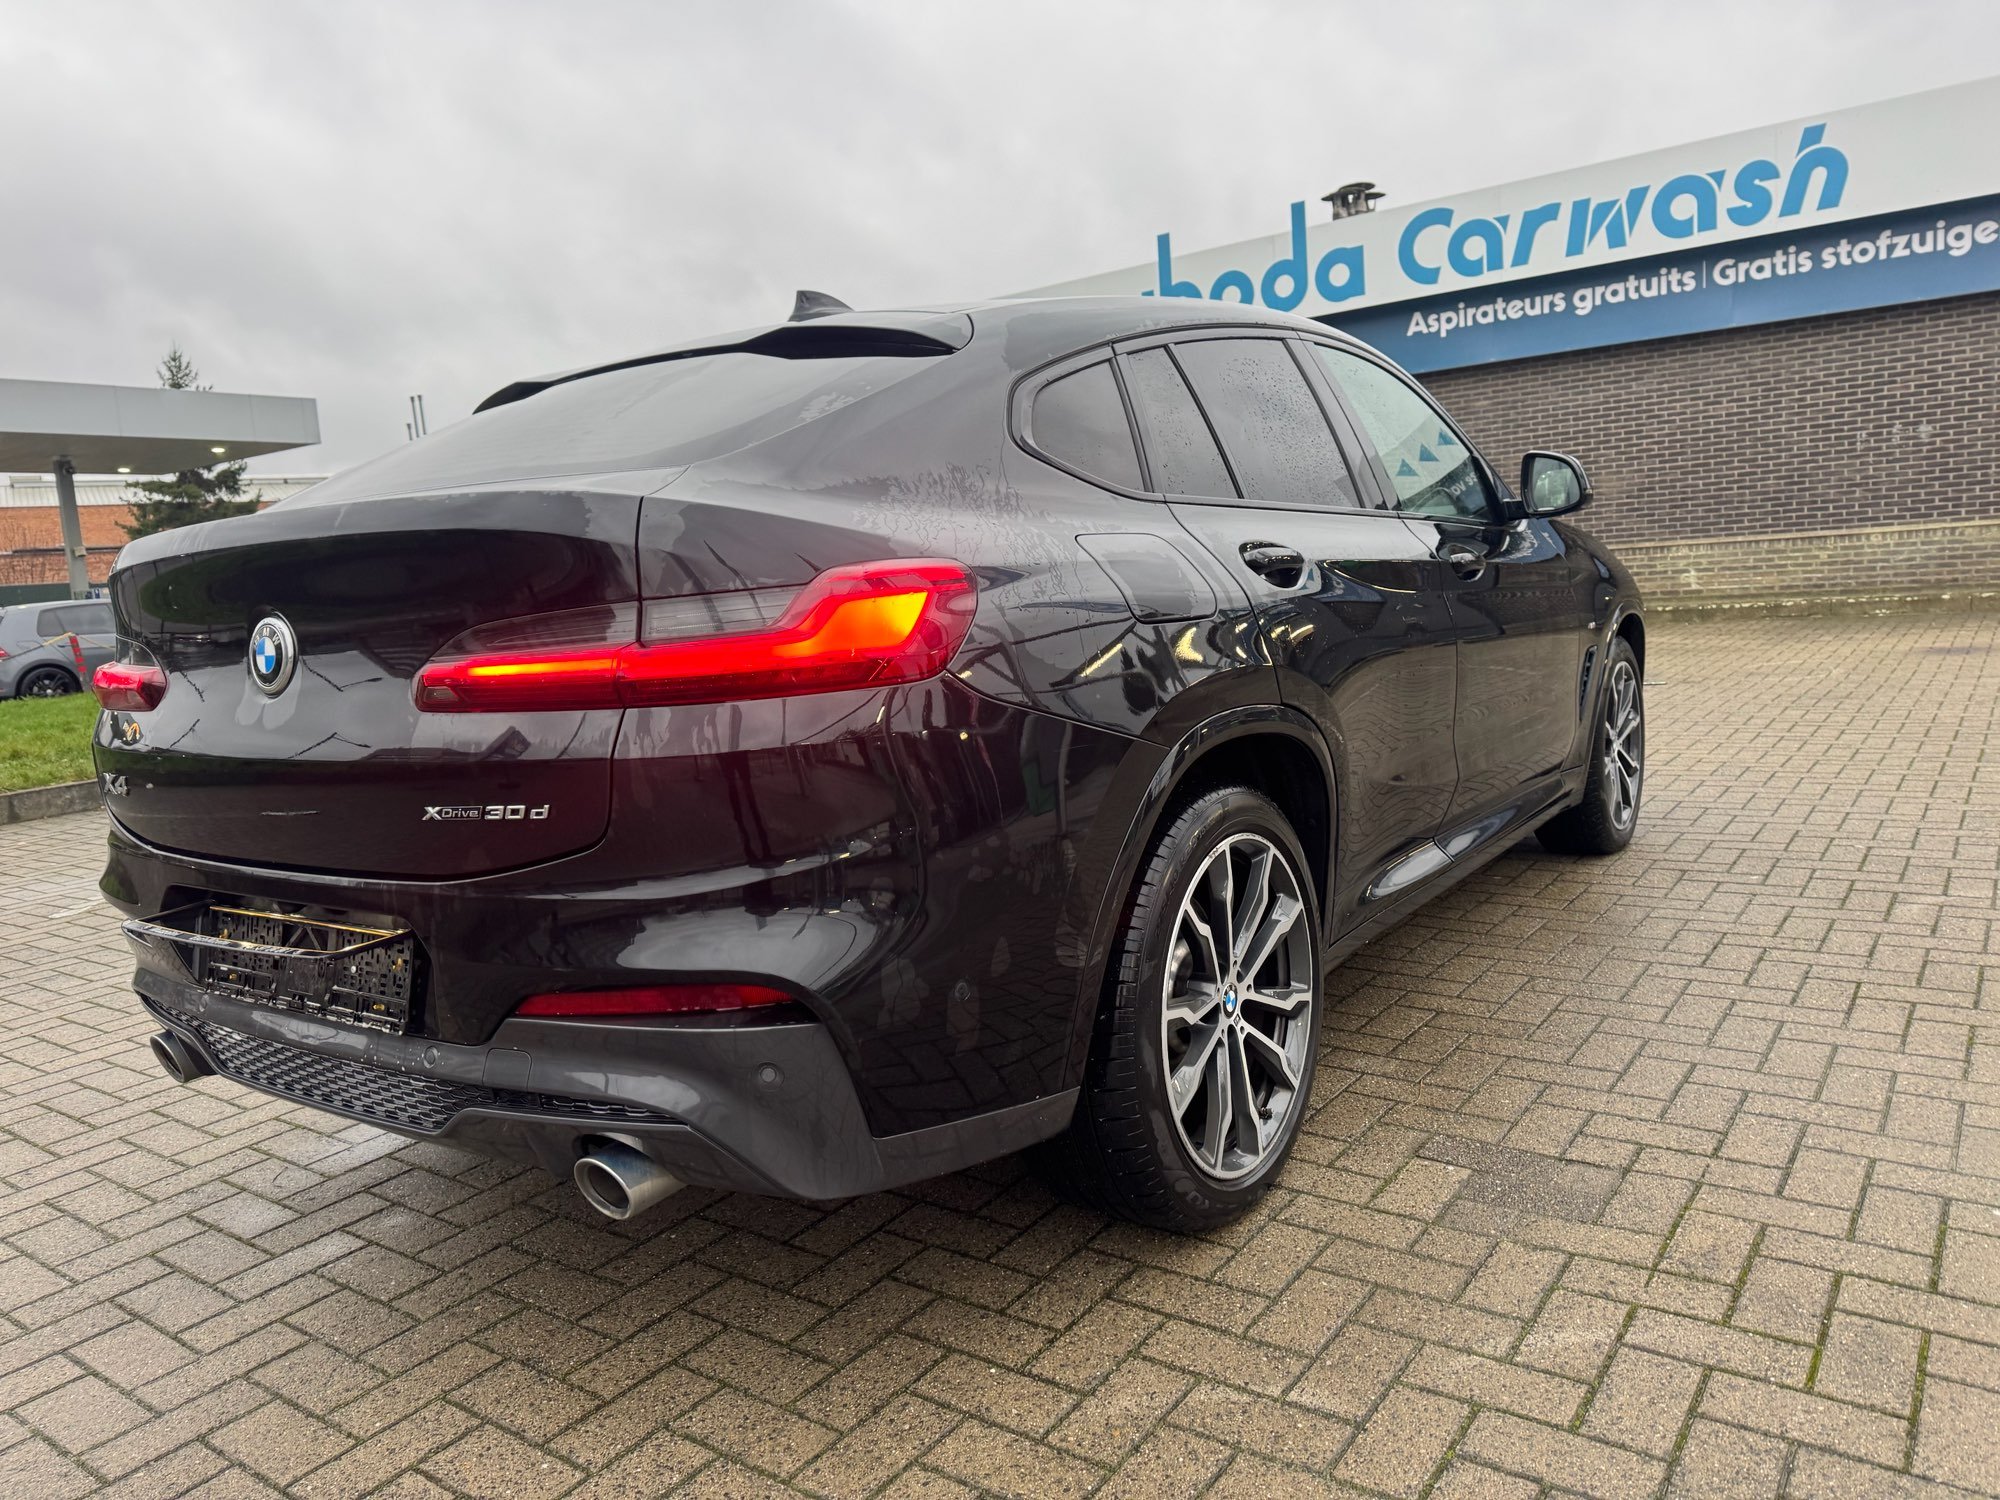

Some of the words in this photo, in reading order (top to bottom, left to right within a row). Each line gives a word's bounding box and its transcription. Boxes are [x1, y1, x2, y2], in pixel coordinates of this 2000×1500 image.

[1397, 122, 1849, 286] Carwash
[1406, 290, 1567, 338] Aspirateurs
[1572, 267, 1697, 316] gratuits
[1712, 245, 1813, 286] Gratis
[103, 772, 128, 797] X4
